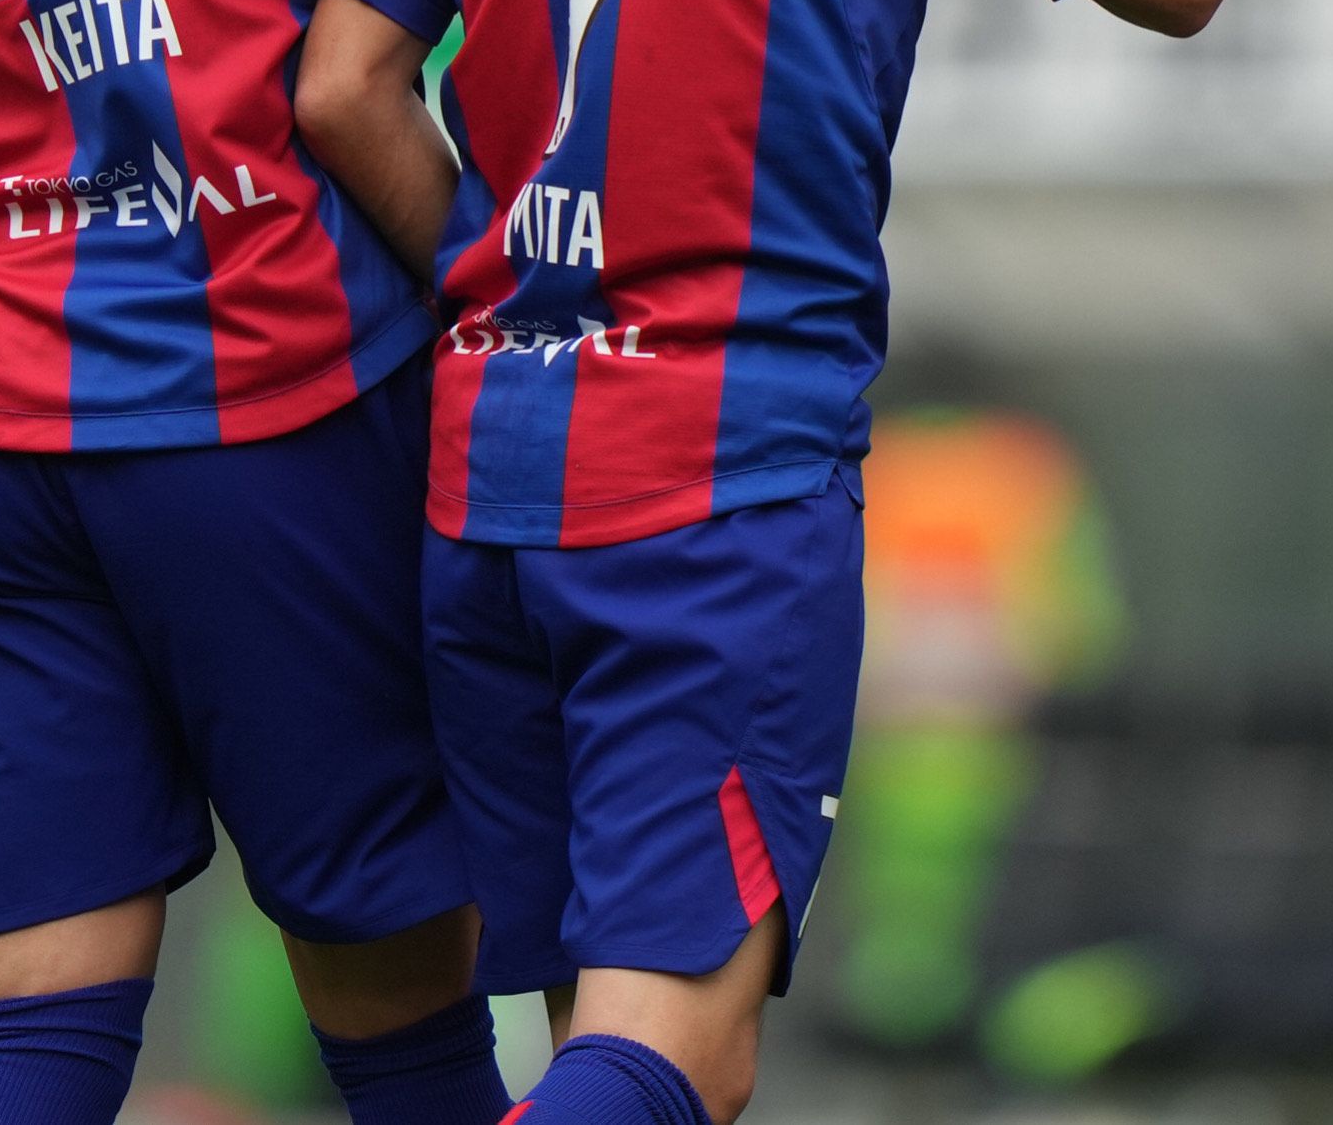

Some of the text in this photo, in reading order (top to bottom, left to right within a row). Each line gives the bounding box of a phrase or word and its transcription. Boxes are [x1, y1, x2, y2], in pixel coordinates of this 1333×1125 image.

[4, 138, 278, 240] LIFEVAL
[24, 159, 138, 197] TOKYO GAS
[504, 181, 605, 270] MITA
